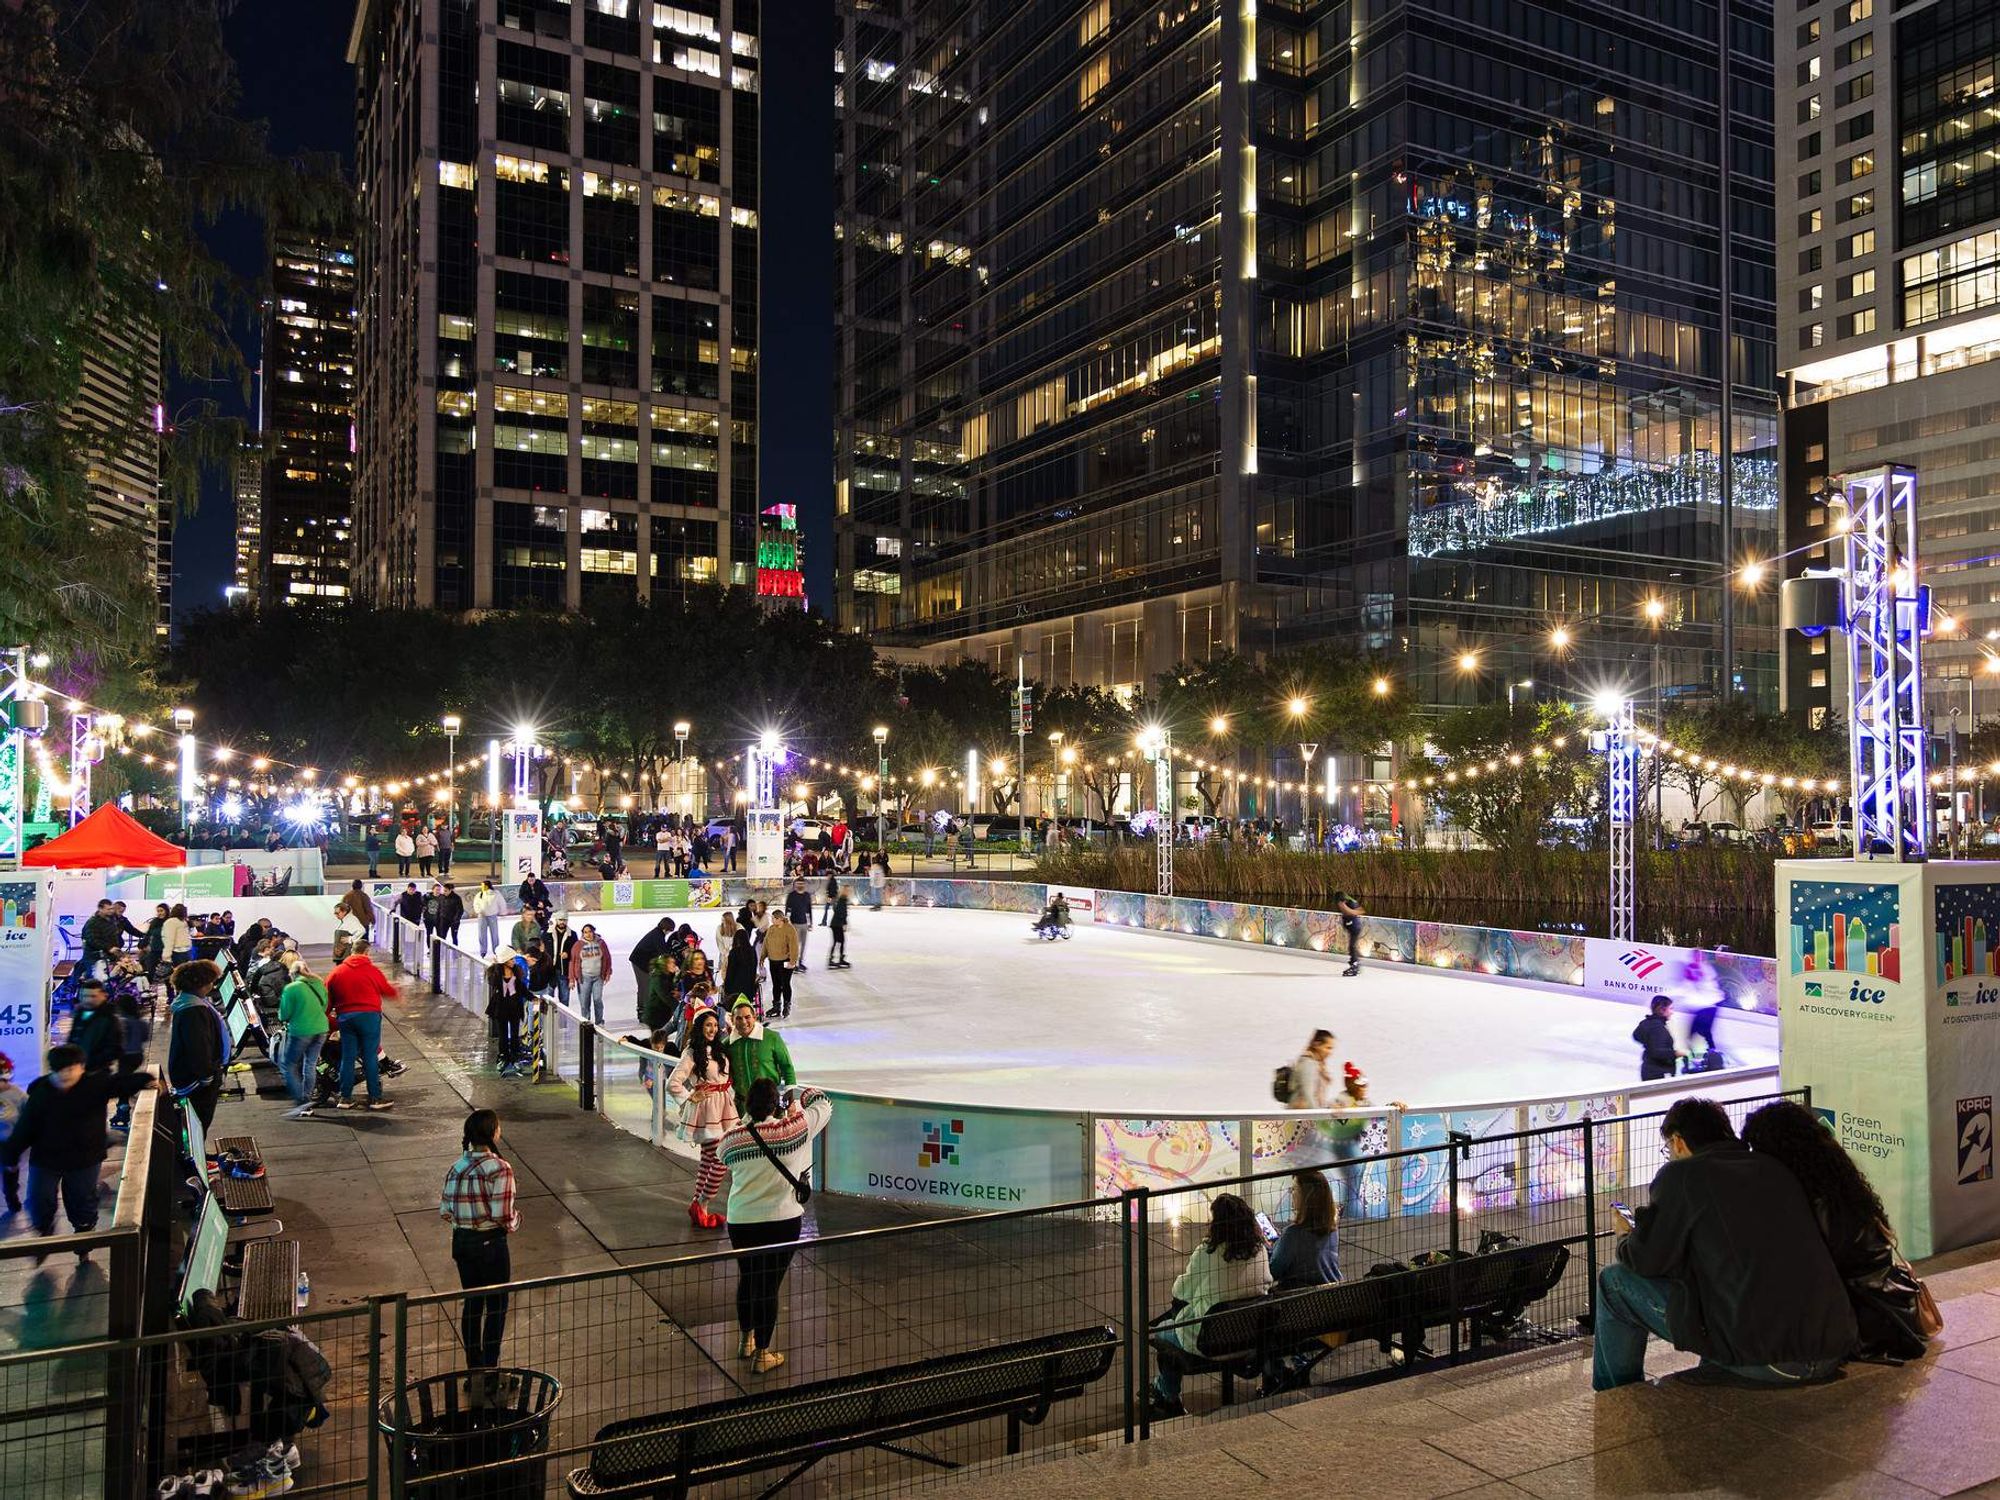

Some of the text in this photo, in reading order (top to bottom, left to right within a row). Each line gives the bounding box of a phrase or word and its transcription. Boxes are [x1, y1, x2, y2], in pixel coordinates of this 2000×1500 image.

[5, 929, 28, 941] ice
[1604, 979, 1627, 989] BANK
[1628, 982, 1638, 990] OF
[1849, 979, 1886, 1004] ice
[1975, 981, 1998, 1004] ice
[1799, 1004, 1810, 1013] AT
[1958, 1097, 1991, 1112] KPRC
[1841, 1112, 1882, 1130] Green
[1841, 1124, 1905, 1148] Mountain
[1841, 1137, 1890, 1159] Energy
[868, 1172, 1021, 1202] DISCOVERYGREEN
